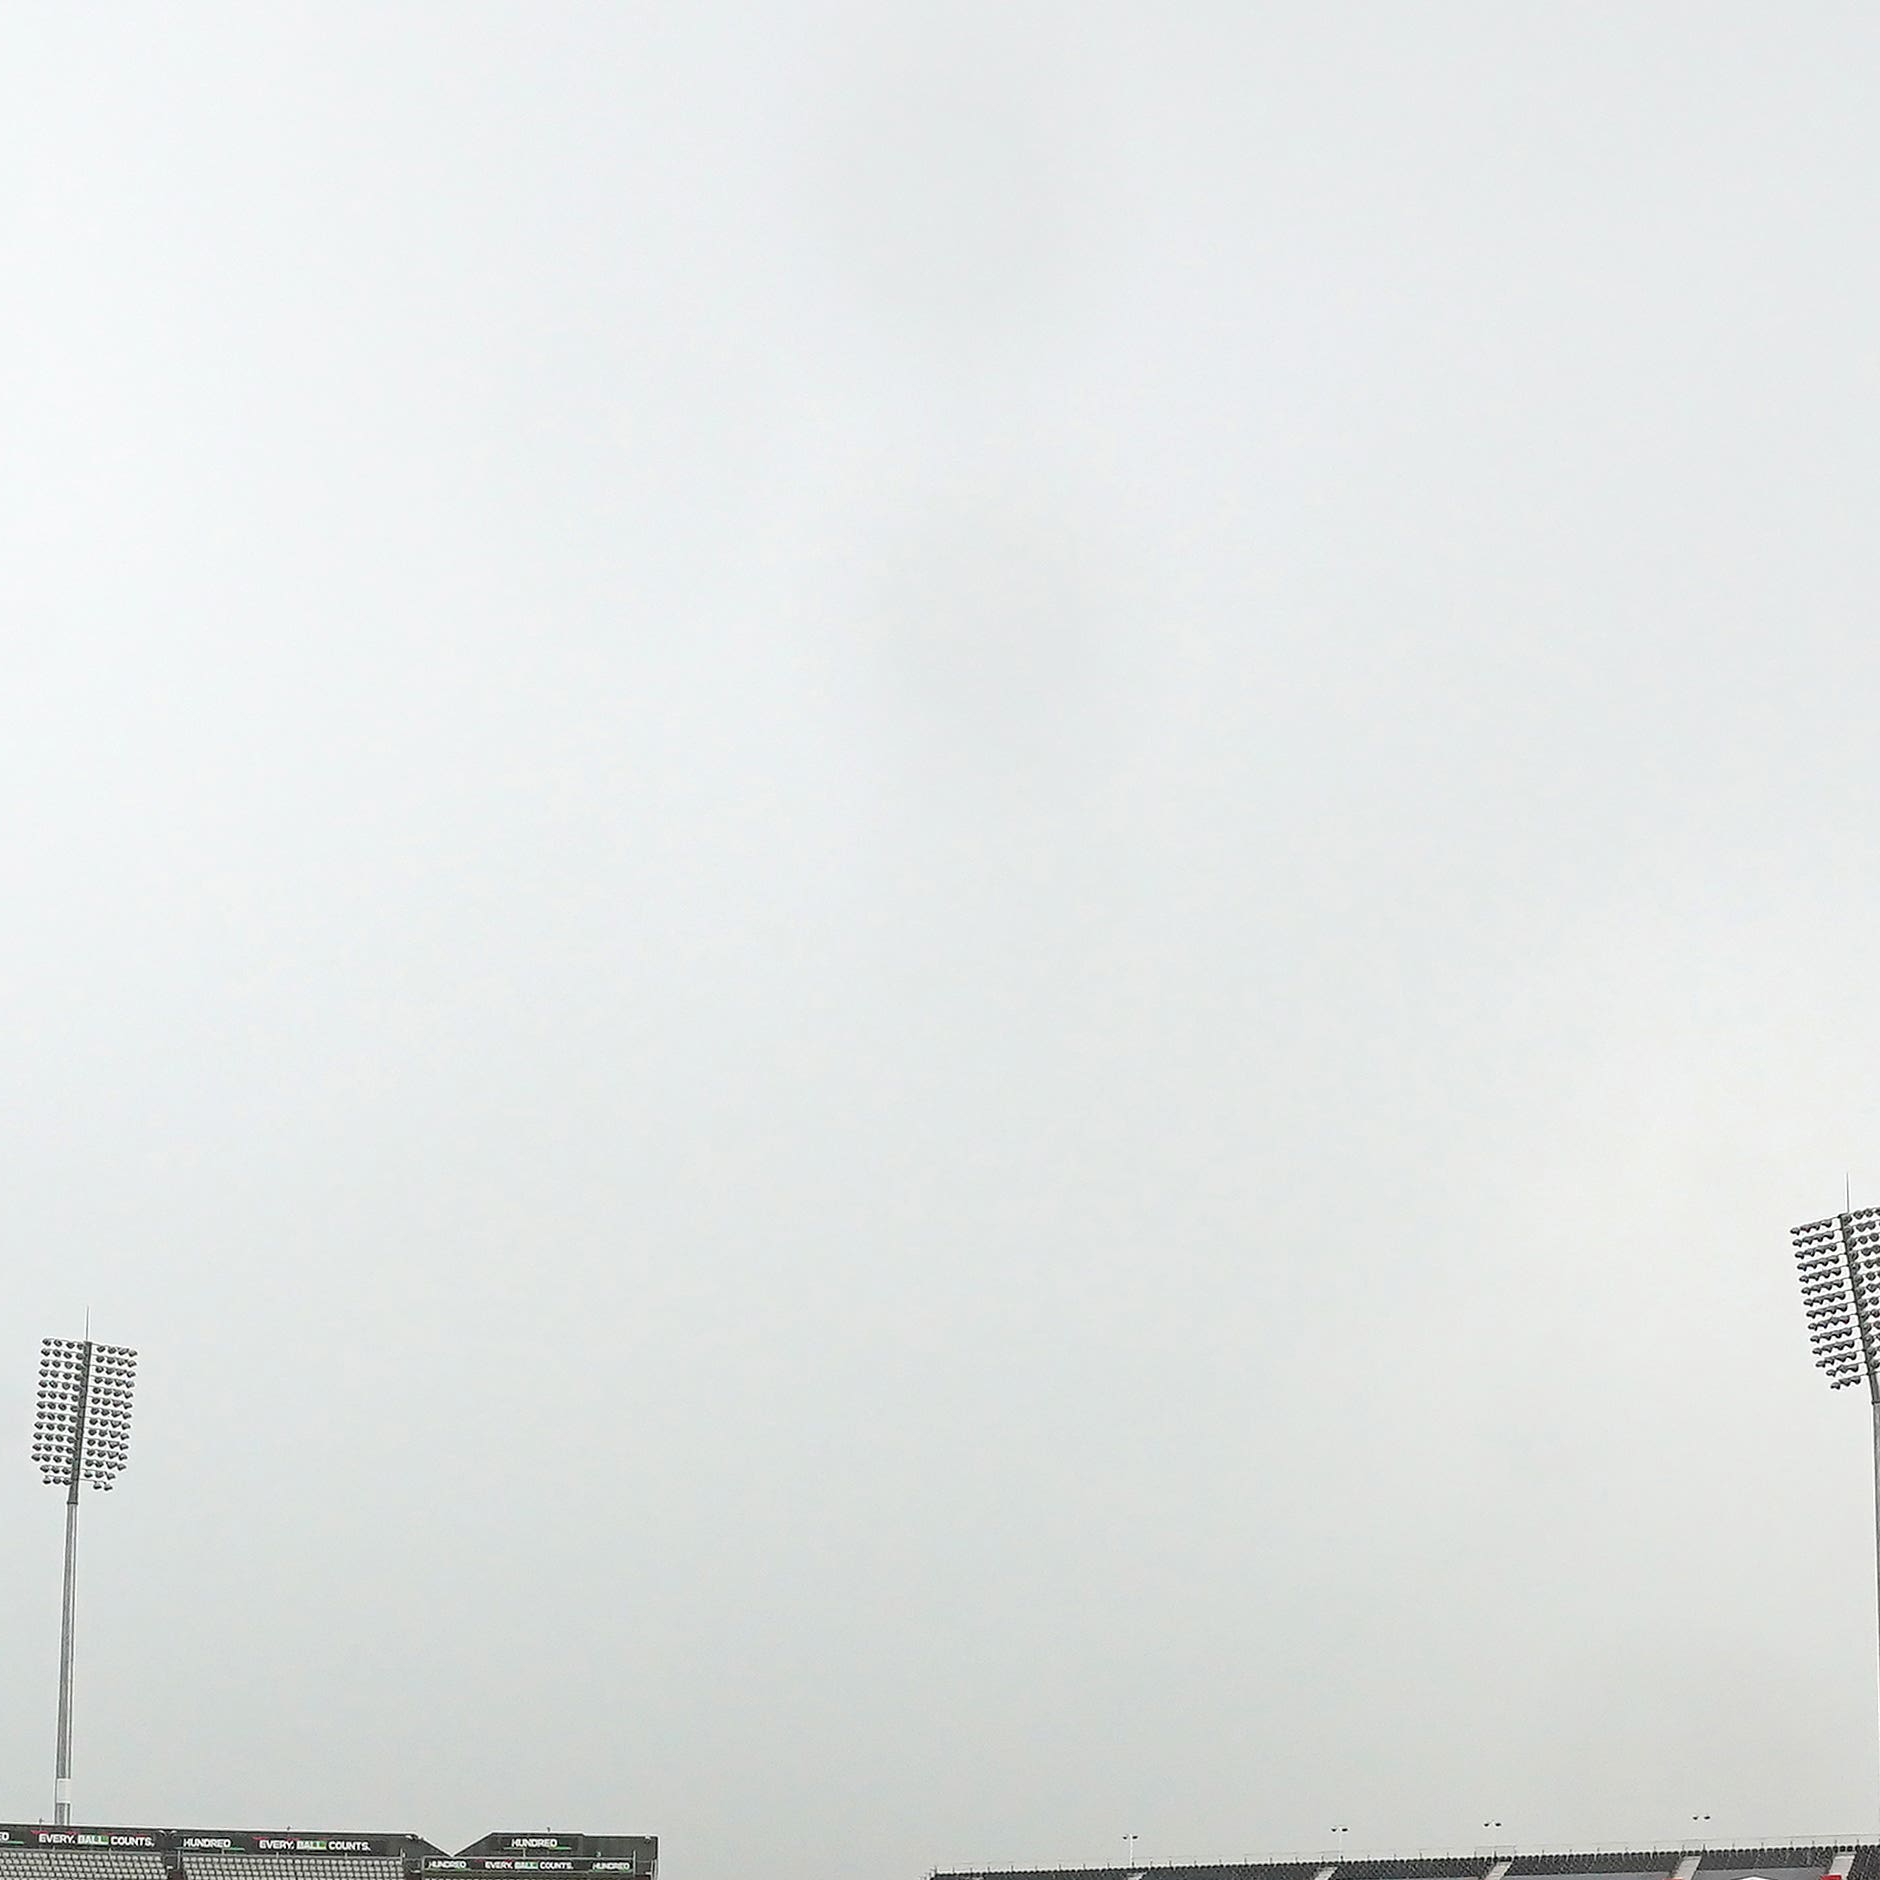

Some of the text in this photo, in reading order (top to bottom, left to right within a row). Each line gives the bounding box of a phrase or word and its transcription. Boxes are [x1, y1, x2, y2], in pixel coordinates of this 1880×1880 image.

[39, 1834, 155, 1847] EVERY. COUNTS.
[183, 1838, 231, 1849] HUNDRED
[259, 1839, 371, 1852] EVERY. COUNTS.
[511, 1838, 558, 1849] HUNDRED
